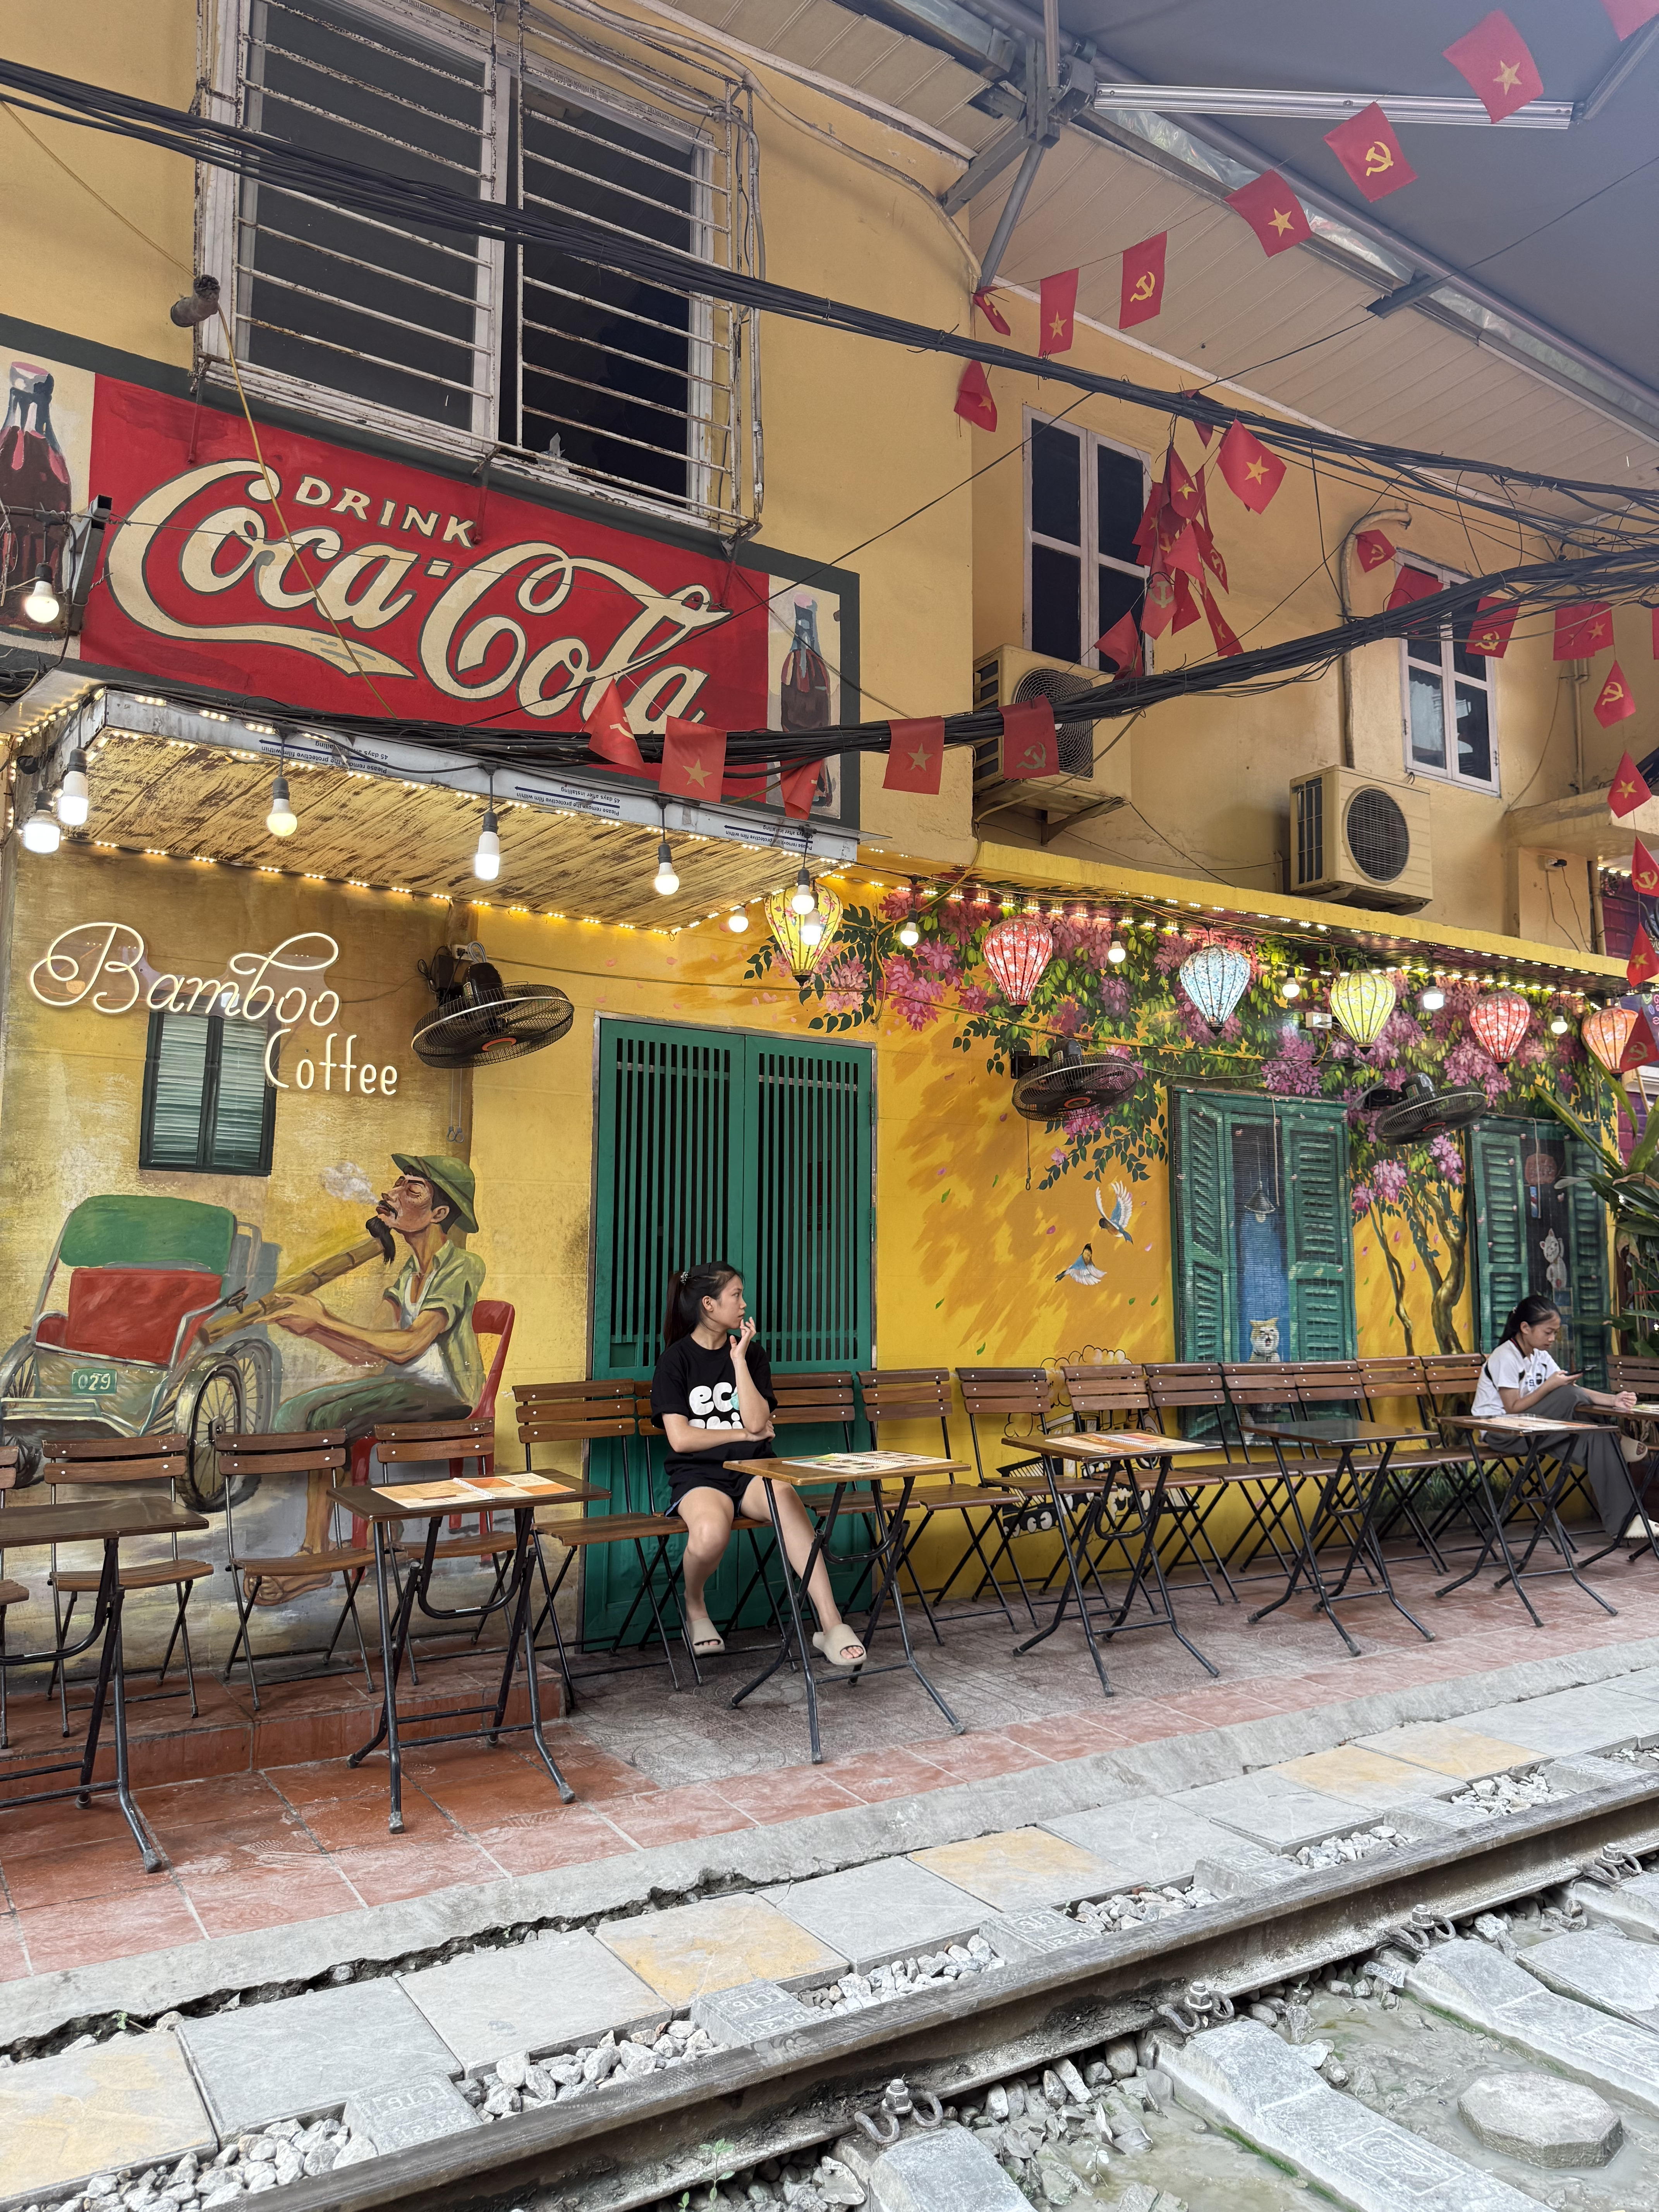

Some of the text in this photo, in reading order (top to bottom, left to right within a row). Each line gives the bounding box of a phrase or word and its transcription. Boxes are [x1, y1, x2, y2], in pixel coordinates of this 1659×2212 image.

[296, 476, 476, 548] DRINK
[297, 753, 328, 762] protective
[367, 765, 387, 774] Please
[561, 787, 585, 797] installing
[546, 798, 572, 806] protective
[30, 922, 340, 1026] Bamboo
[266, 1029, 398, 1095] Coffee
[78, 1373, 111, 1391] 029
